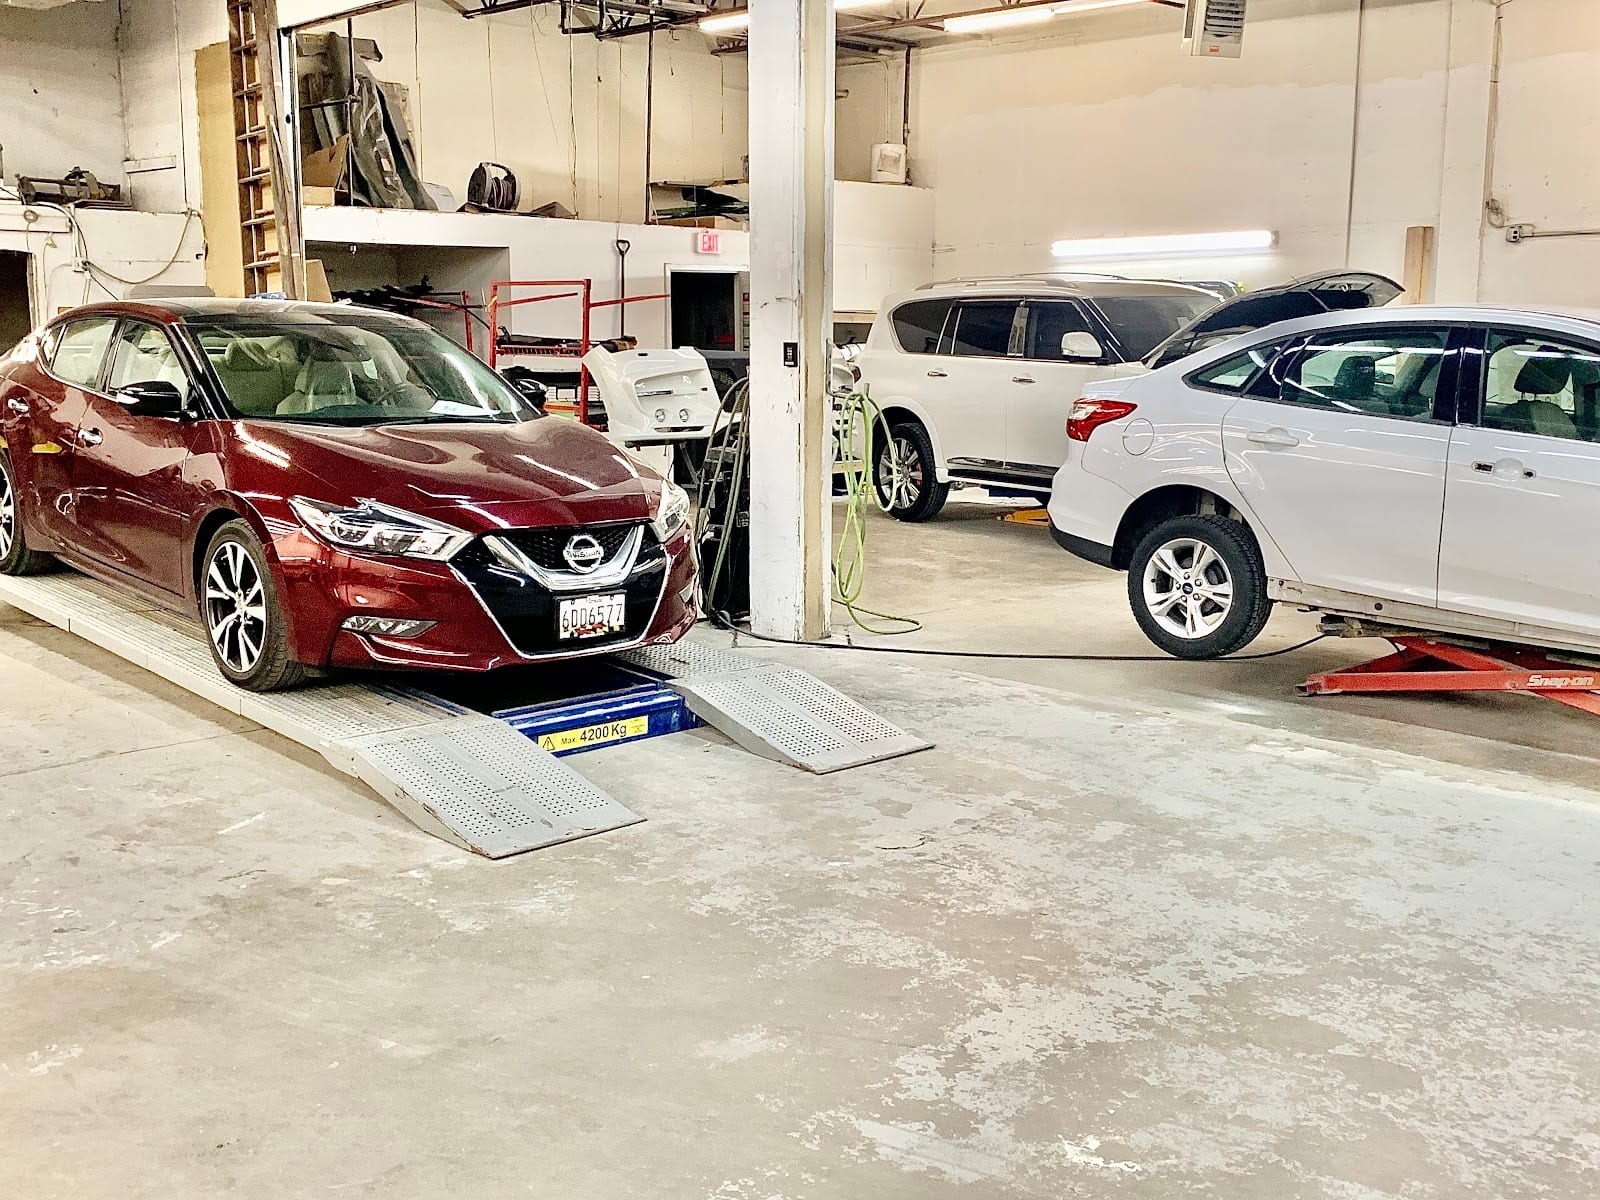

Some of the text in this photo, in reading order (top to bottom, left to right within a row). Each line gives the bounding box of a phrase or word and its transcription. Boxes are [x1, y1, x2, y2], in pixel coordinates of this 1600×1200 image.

[702, 234, 719, 252] EXIT
[1527, 674, 1594, 688] Snap-on
[580, 725, 609, 742] 4200
[611, 723, 627, 738] Kg
